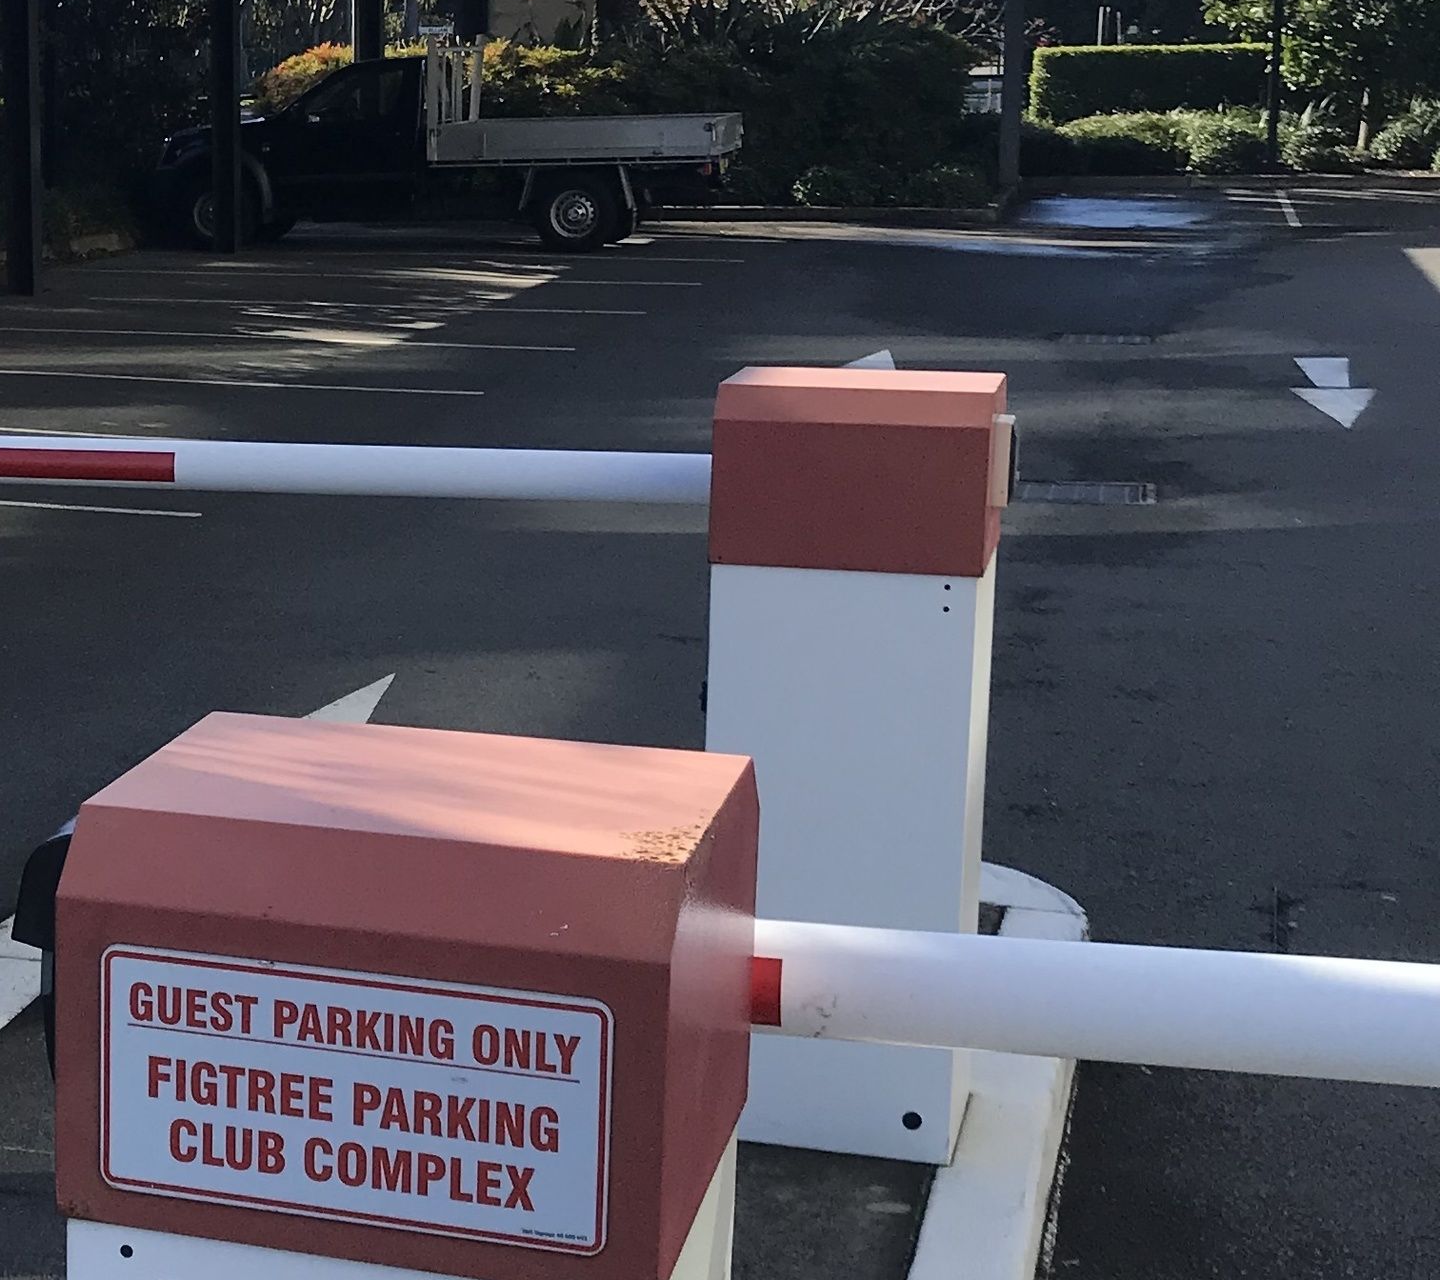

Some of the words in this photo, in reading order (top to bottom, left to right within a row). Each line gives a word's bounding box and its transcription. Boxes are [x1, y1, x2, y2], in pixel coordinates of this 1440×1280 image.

[130, 982, 257, 1033] GUEST
[274, 1000, 453, 1060] PARKING
[473, 1025, 580, 1073] ONLY
[148, 1056, 332, 1121] FIGTREE
[353, 1083, 559, 1151] PARKING
[170, 1119, 284, 1173] CLUB
[305, 1137, 534, 1211] COMPLEX
